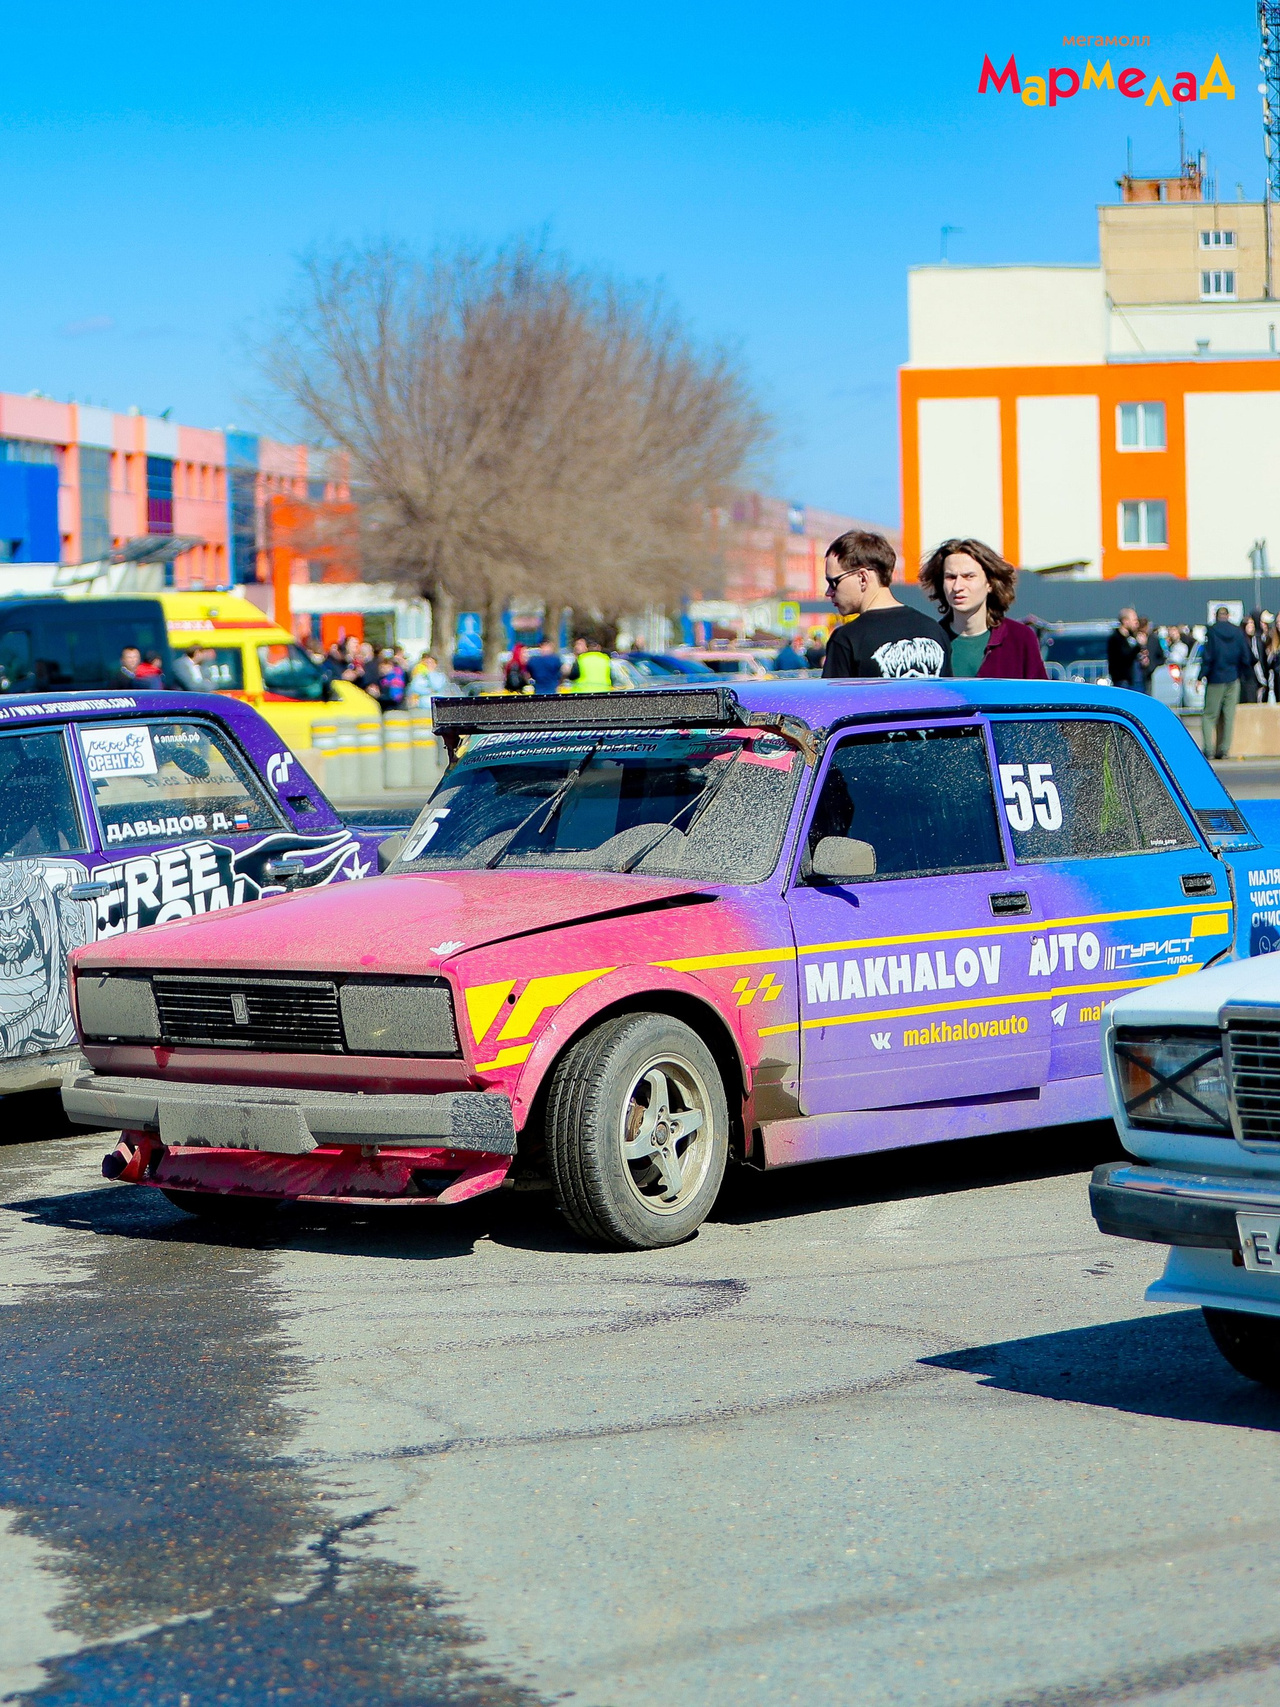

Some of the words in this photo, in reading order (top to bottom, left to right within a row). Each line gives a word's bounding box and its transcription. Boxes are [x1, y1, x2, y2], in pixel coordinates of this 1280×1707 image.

[87, 752, 144, 772] ОРЕНГАЗ
[998, 763, 1063, 832] 55
[107, 814, 207, 842] ДАВЫДОВ
[213, 812, 233, 830] Д.
[94, 843, 221, 927] FREE
[1250, 889, 1280, 907] ЧИСТ
[1116, 938, 1195, 959] ТУРИСТ
[804, 945, 1002, 1004] MAKHALOV
[903, 1015, 1028, 1047] makhalovauto
